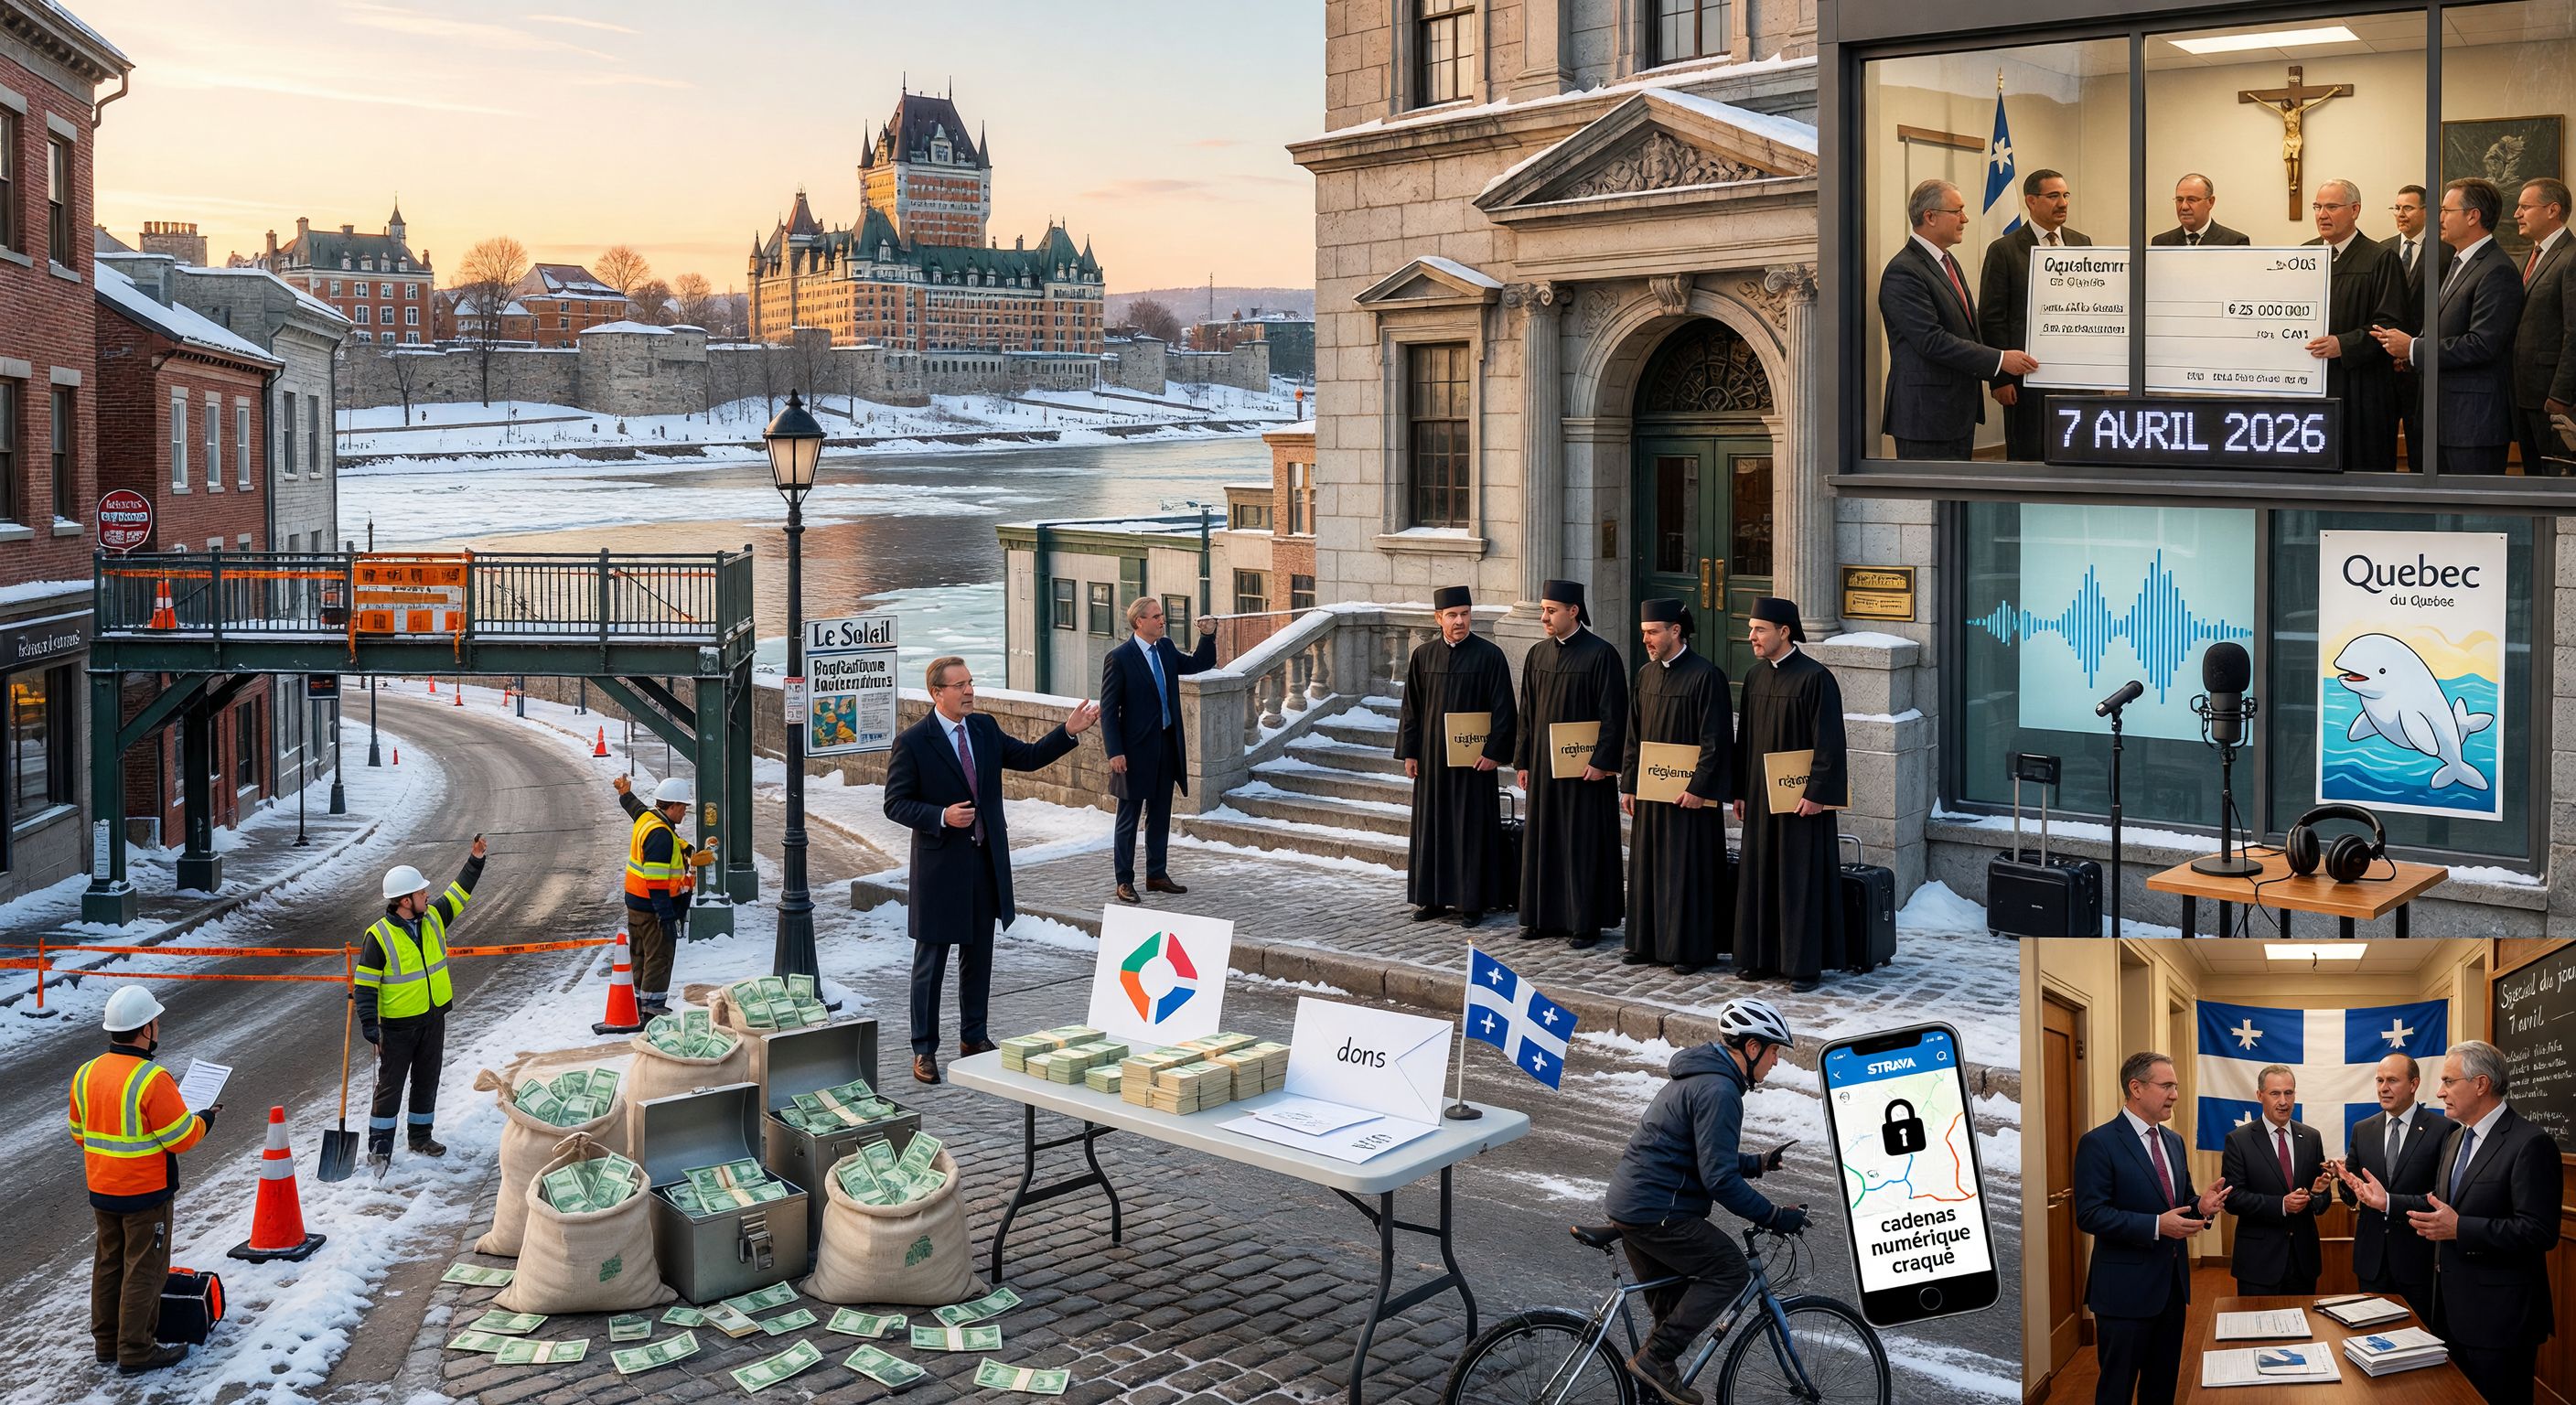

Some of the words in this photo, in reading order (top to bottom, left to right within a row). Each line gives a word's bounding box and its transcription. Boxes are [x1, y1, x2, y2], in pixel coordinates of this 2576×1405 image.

[2238, 305, 2253, 316] 25
[2258, 305, 2282, 316] 000
[2058, 410, 2081, 447] 7
[2095, 410, 2209, 451] AVRIL
[2224, 413, 2326, 454] 2026
[2343, 553, 2481, 595] Quebec
[2389, 594, 2407, 606] du
[813, 623, 835, 647] Le
[2557, 961, 2576, 993] jou
[1336, 1036, 1387, 1068] dons
[1867, 1056, 1916, 1075] STRAVA
[1881, 1208, 1957, 1233] cadenas
[1871, 1227, 1970, 1256] numérique
[1892, 1246, 1955, 1273] craqué
